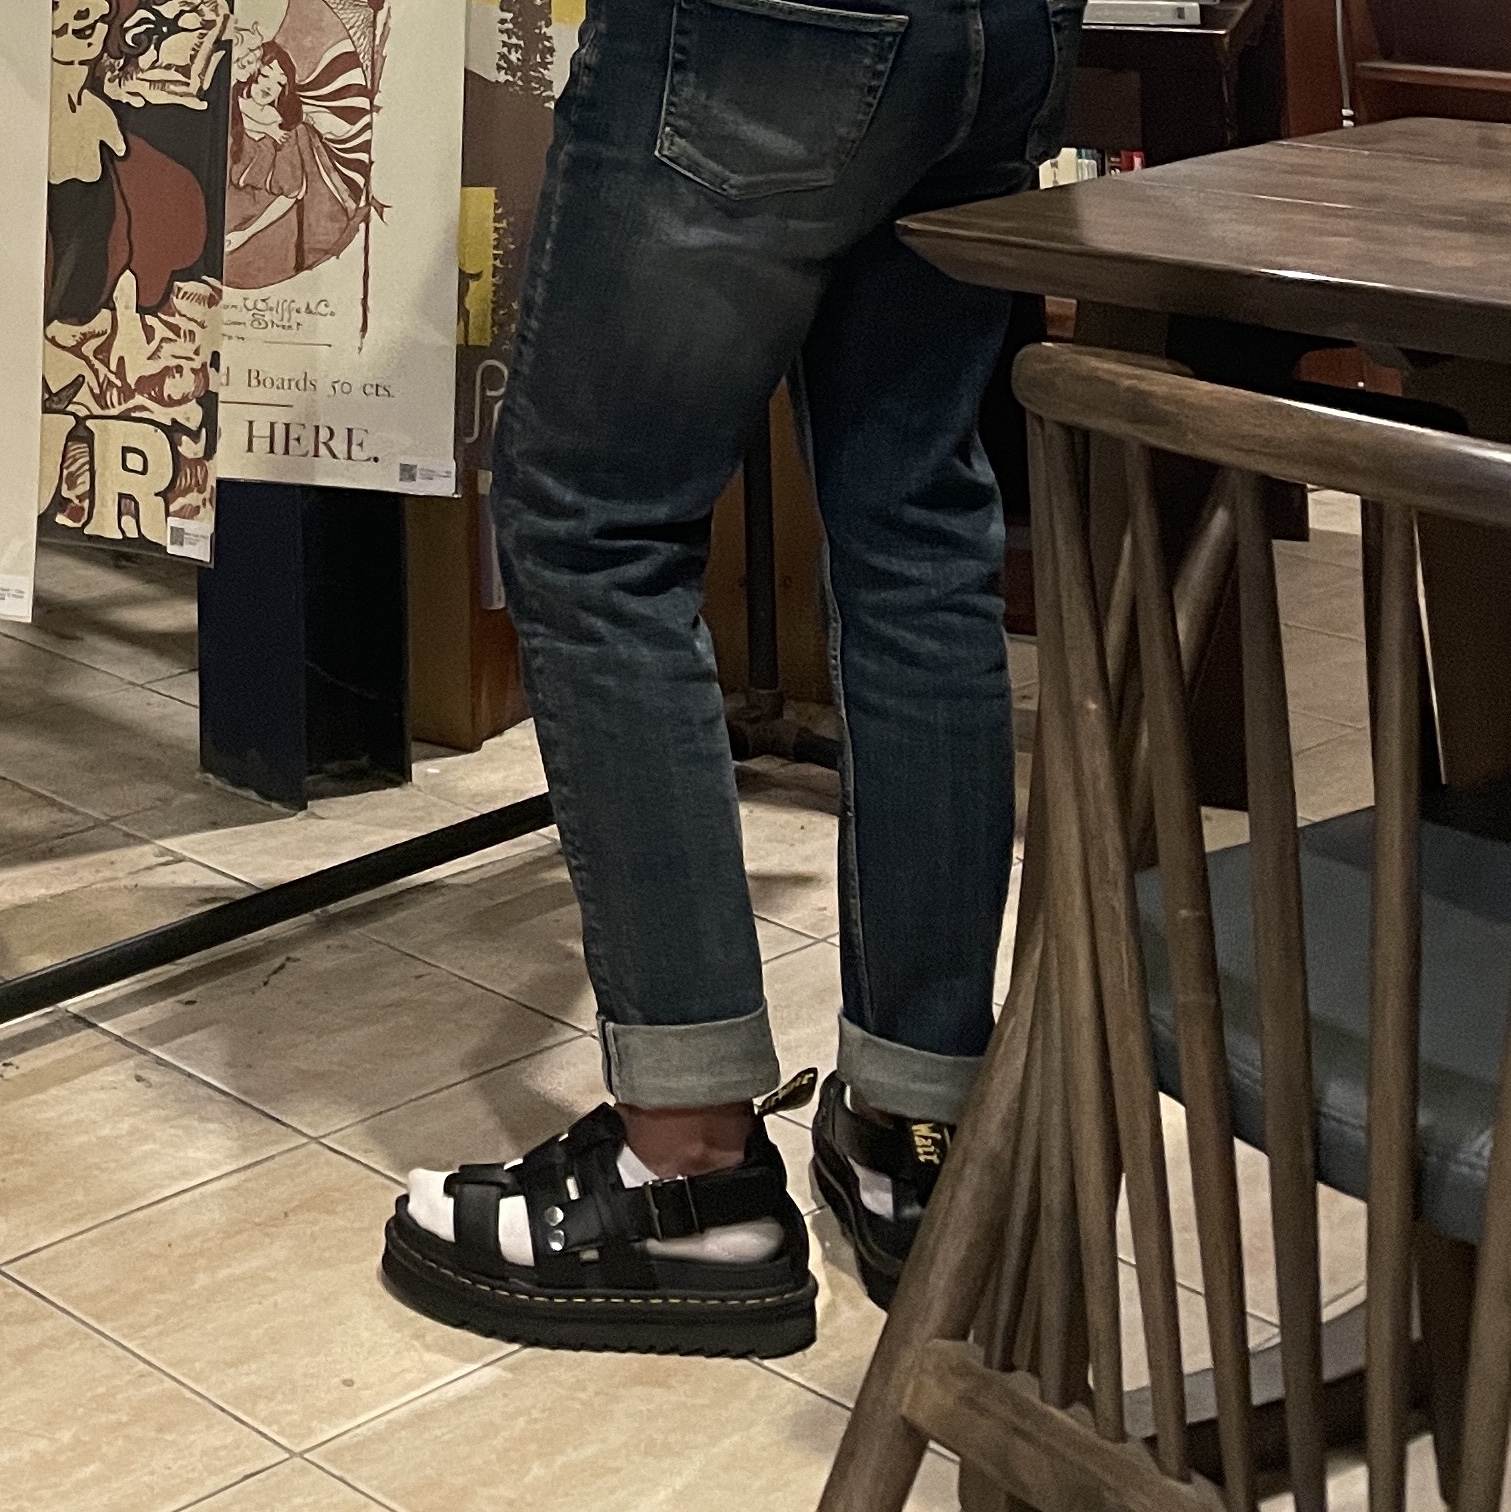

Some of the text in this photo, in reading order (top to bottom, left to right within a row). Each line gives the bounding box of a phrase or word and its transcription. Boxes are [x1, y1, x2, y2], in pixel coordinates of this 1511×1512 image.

[247, 368, 318, 393] Boards
[327, 379, 352, 398] 50
[245, 419, 381, 464] HERE.
